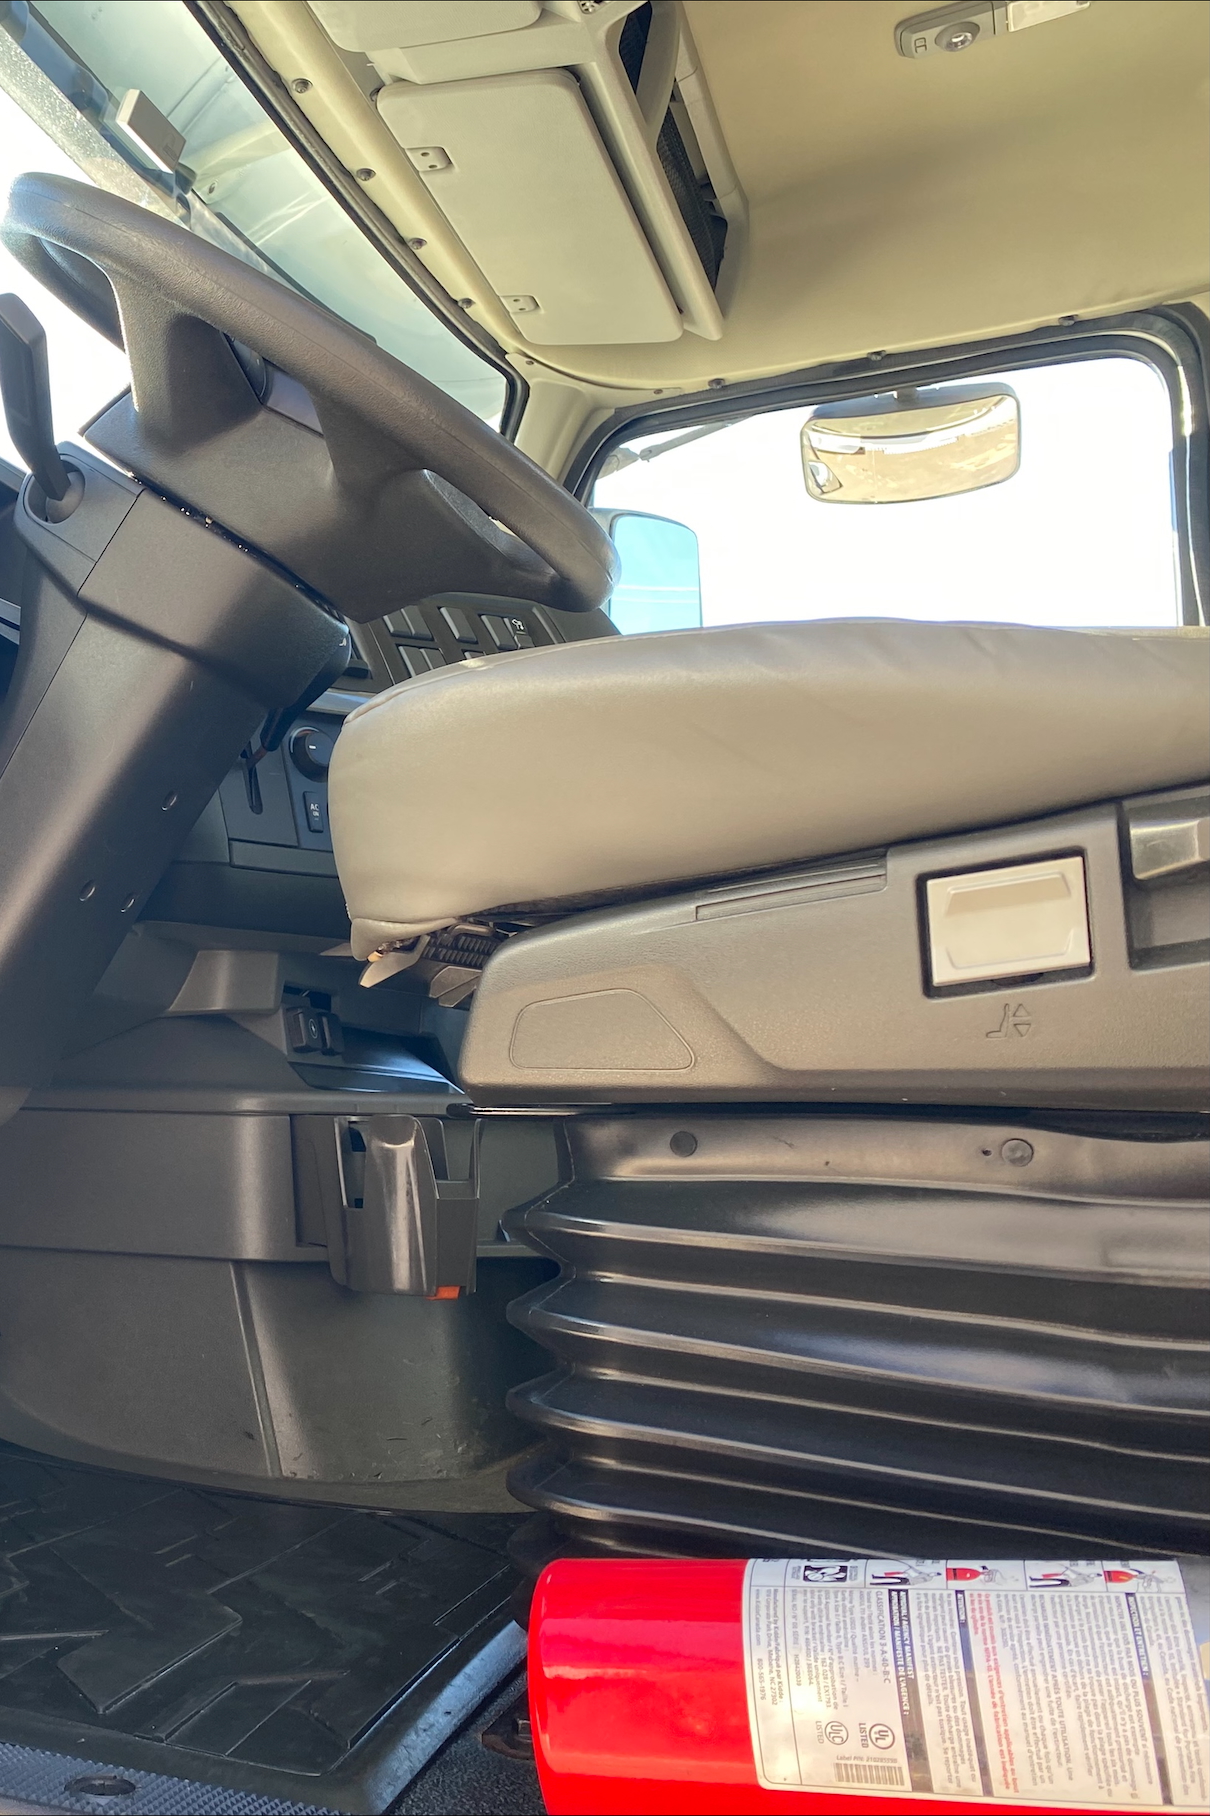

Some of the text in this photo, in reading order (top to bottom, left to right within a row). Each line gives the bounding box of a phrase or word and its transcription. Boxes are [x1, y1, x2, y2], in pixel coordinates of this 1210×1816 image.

[876, 1591, 886, 1640] CLASSIFICATION
[894, 1631, 905, 1665] MANIFESTE
[901, 1621, 910, 1645] AGENCY
[1128, 1597, 1140, 1627] INSPECTION
[1136, 1636, 1148, 1671] ENTRETIEN
[898, 1667, 905, 1675] DE
[905, 1646, 914, 1679] MANIFEST
[757, 1659, 766, 1700] 800-565-1976
[899, 1678, 910, 1710] L'AGENCE
[940, 1669, 948, 1692] TESTER.
[1127, 1660, 1147, 1742] MOIS OU PLUS SOUVENT
[815, 1721, 824, 1744] LISTED
[829, 1725, 844, 1743] ULC
[859, 1723, 869, 1748] LISTED
[875, 1730, 889, 1743] UL
[1055, 1697, 1071, 1765] TOUTE UTILISATION.
[939, 1719, 947, 1745] toxique.
[944, 1757, 953, 1784] reporter
